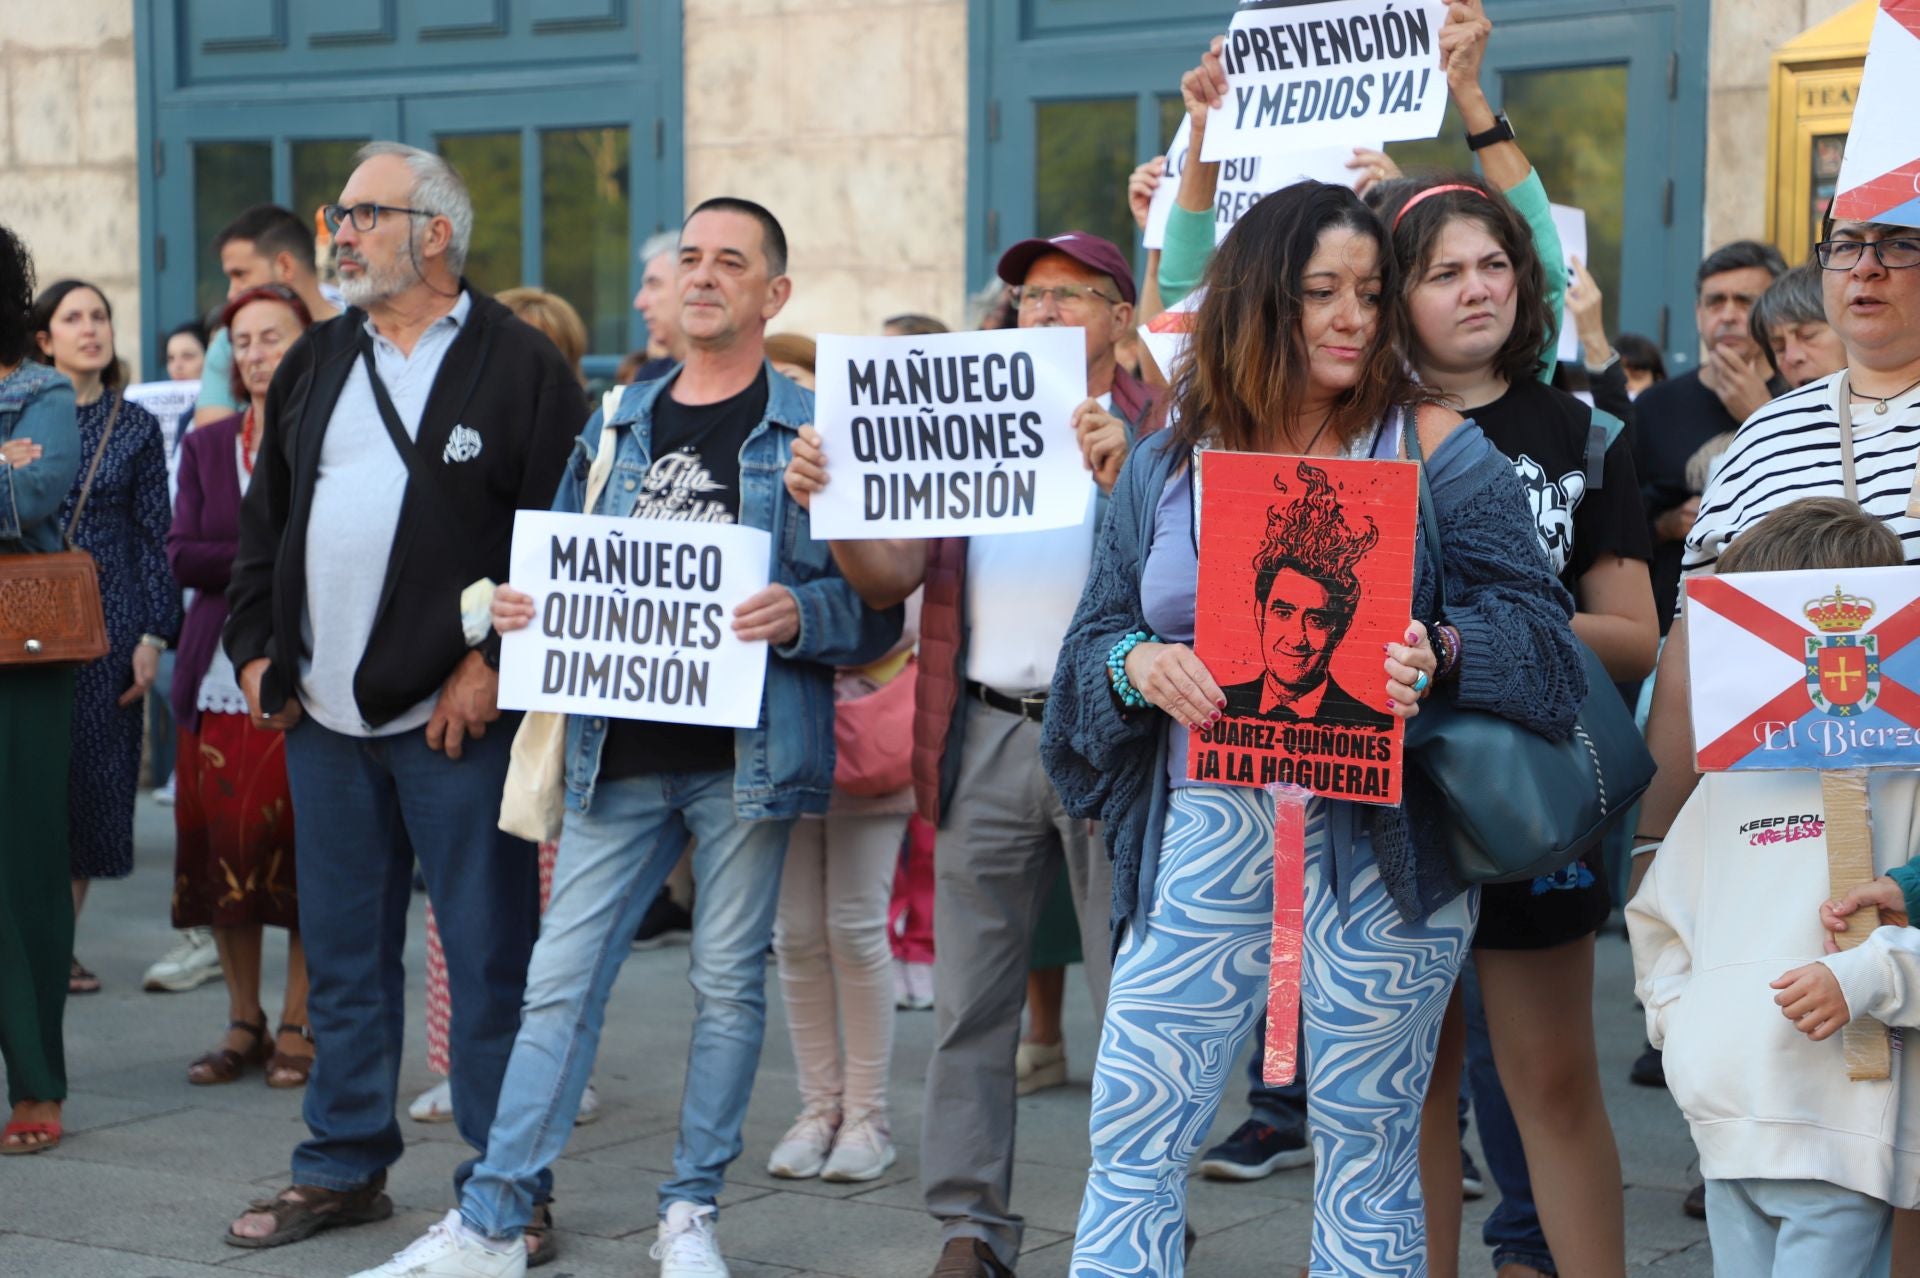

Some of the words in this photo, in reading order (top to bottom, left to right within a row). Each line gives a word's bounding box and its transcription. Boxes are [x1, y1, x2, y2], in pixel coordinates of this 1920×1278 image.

[1225, 4, 1430, 75] ¡PREVENCIÓN
[1236, 86, 1254, 129] Y
[1255, 73, 1376, 128] MEDIOS
[1379, 68, 1430, 114] YA!
[848, 349, 1035, 405] MAÑUECO
[851, 408, 1044, 464] QUIÑONES
[864, 462, 1036, 520] DIMISIÓN
[550, 531, 722, 592] MAÑUECO
[543, 588, 723, 650] QUIÑONES
[542, 650, 709, 706] DIMISIÓN
[1753, 721, 1798, 750] El
[1196, 750, 1220, 780] ¡A
[1226, 752, 1254, 783] LA
[1260, 756, 1391, 798] HOGUERA!
[1740, 817, 1785, 834] KEEP
